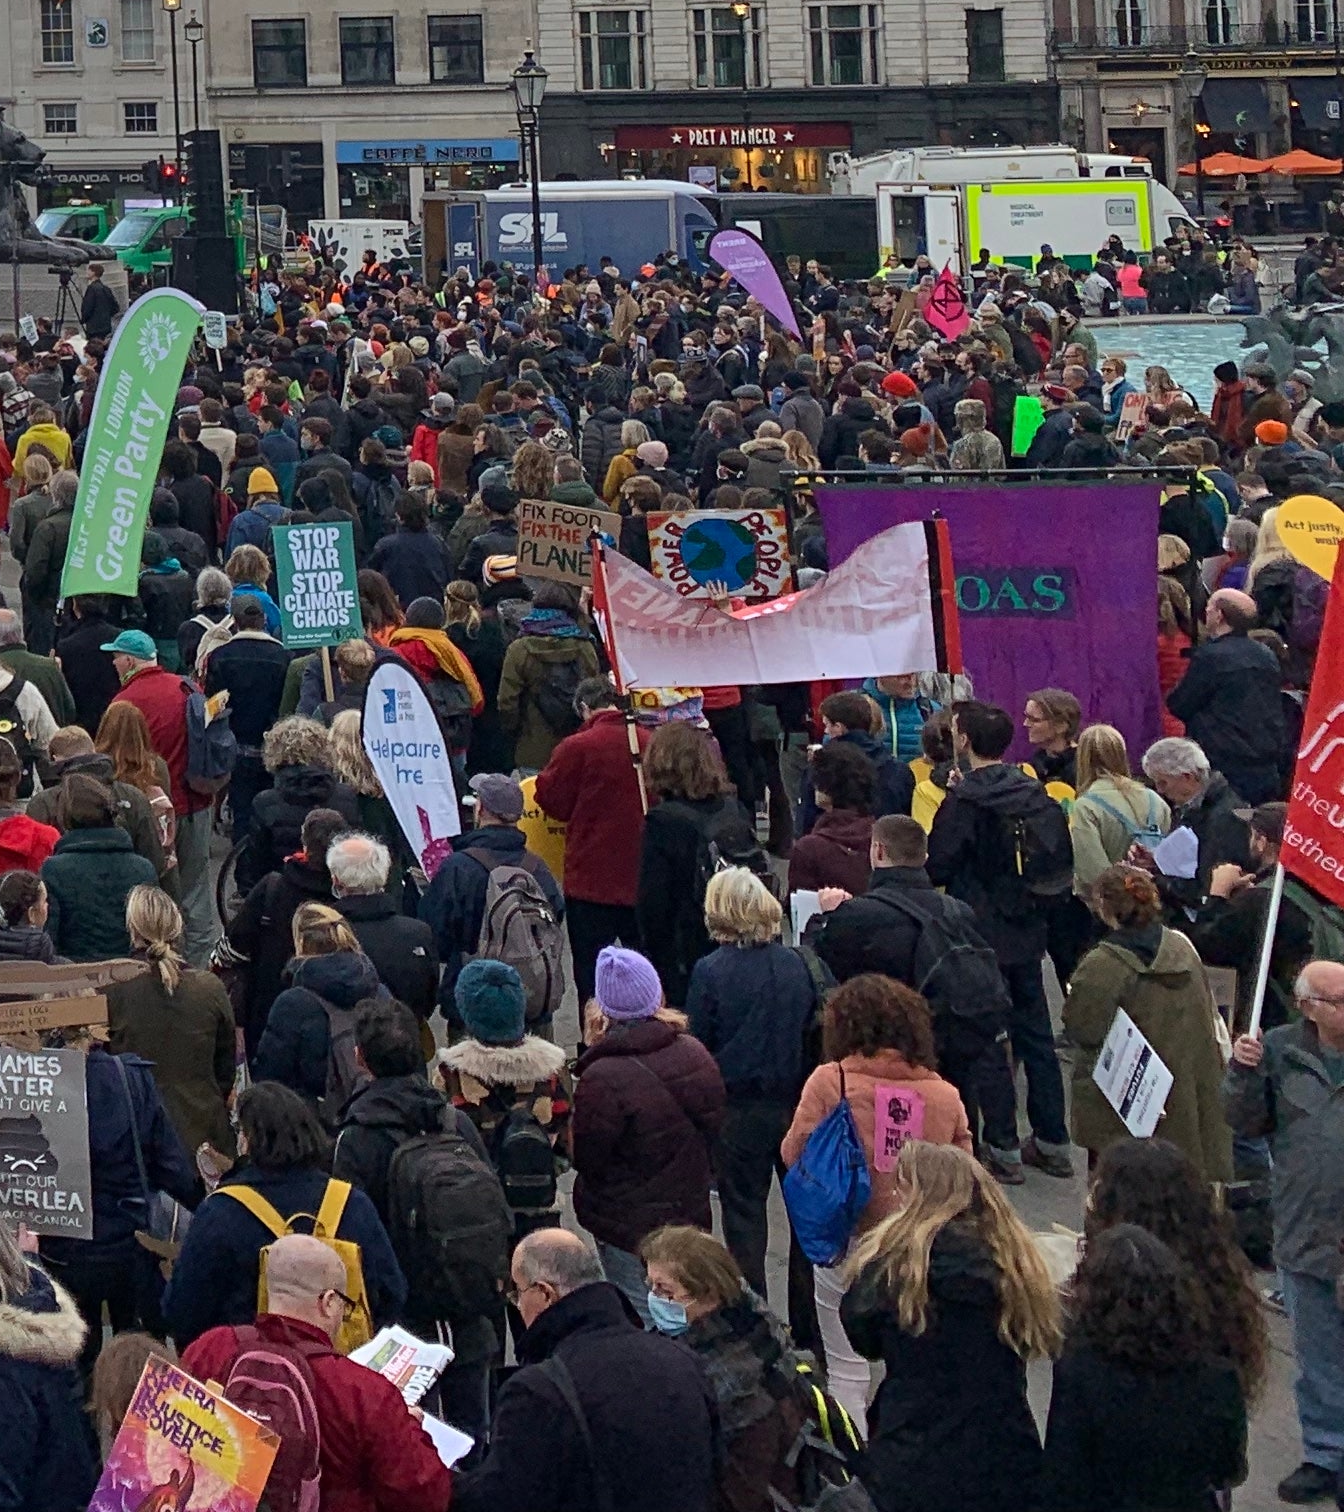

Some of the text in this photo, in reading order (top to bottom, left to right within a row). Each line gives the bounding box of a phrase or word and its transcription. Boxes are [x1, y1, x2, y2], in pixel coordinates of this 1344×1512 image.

[689, 128, 777, 146] PRET A MANGER
[436, 146, 492, 159] NERO
[58, 174, 110, 183] GANDA
[499, 212, 568, 243] SFL
[454, 242, 475, 257] SFL
[104, 369, 134, 439] LONDON
[95, 389, 166, 582] Green Party
[522, 503, 602, 529] FIX FOOD
[1284, 519, 1305, 530] Act
[287, 527, 340, 550] STOP
[521, 520, 582, 545] FIX THE
[291, 548, 340, 570] WAR
[519, 540, 593, 577] PLANE
[662, 522, 701, 597] POWER
[292, 571, 344, 595] STOP
[955, 575, 1066, 612] OAS
[284, 590, 355, 612] CLIMATE
[293, 608, 350, 629] CHAOS
[19, 1099, 51, 1112] GIVE
[56, 1100, 68, 1113] A
[885, 1137, 904, 1150] NO
[25, 1173, 58, 1188] OUR
[41, 1191, 85, 1213] LEA
[181, 1383, 217, 1416] ERA
[138, 1387, 225, 1458] INJUSTICE
[149, 1406, 195, 1455] OVER
